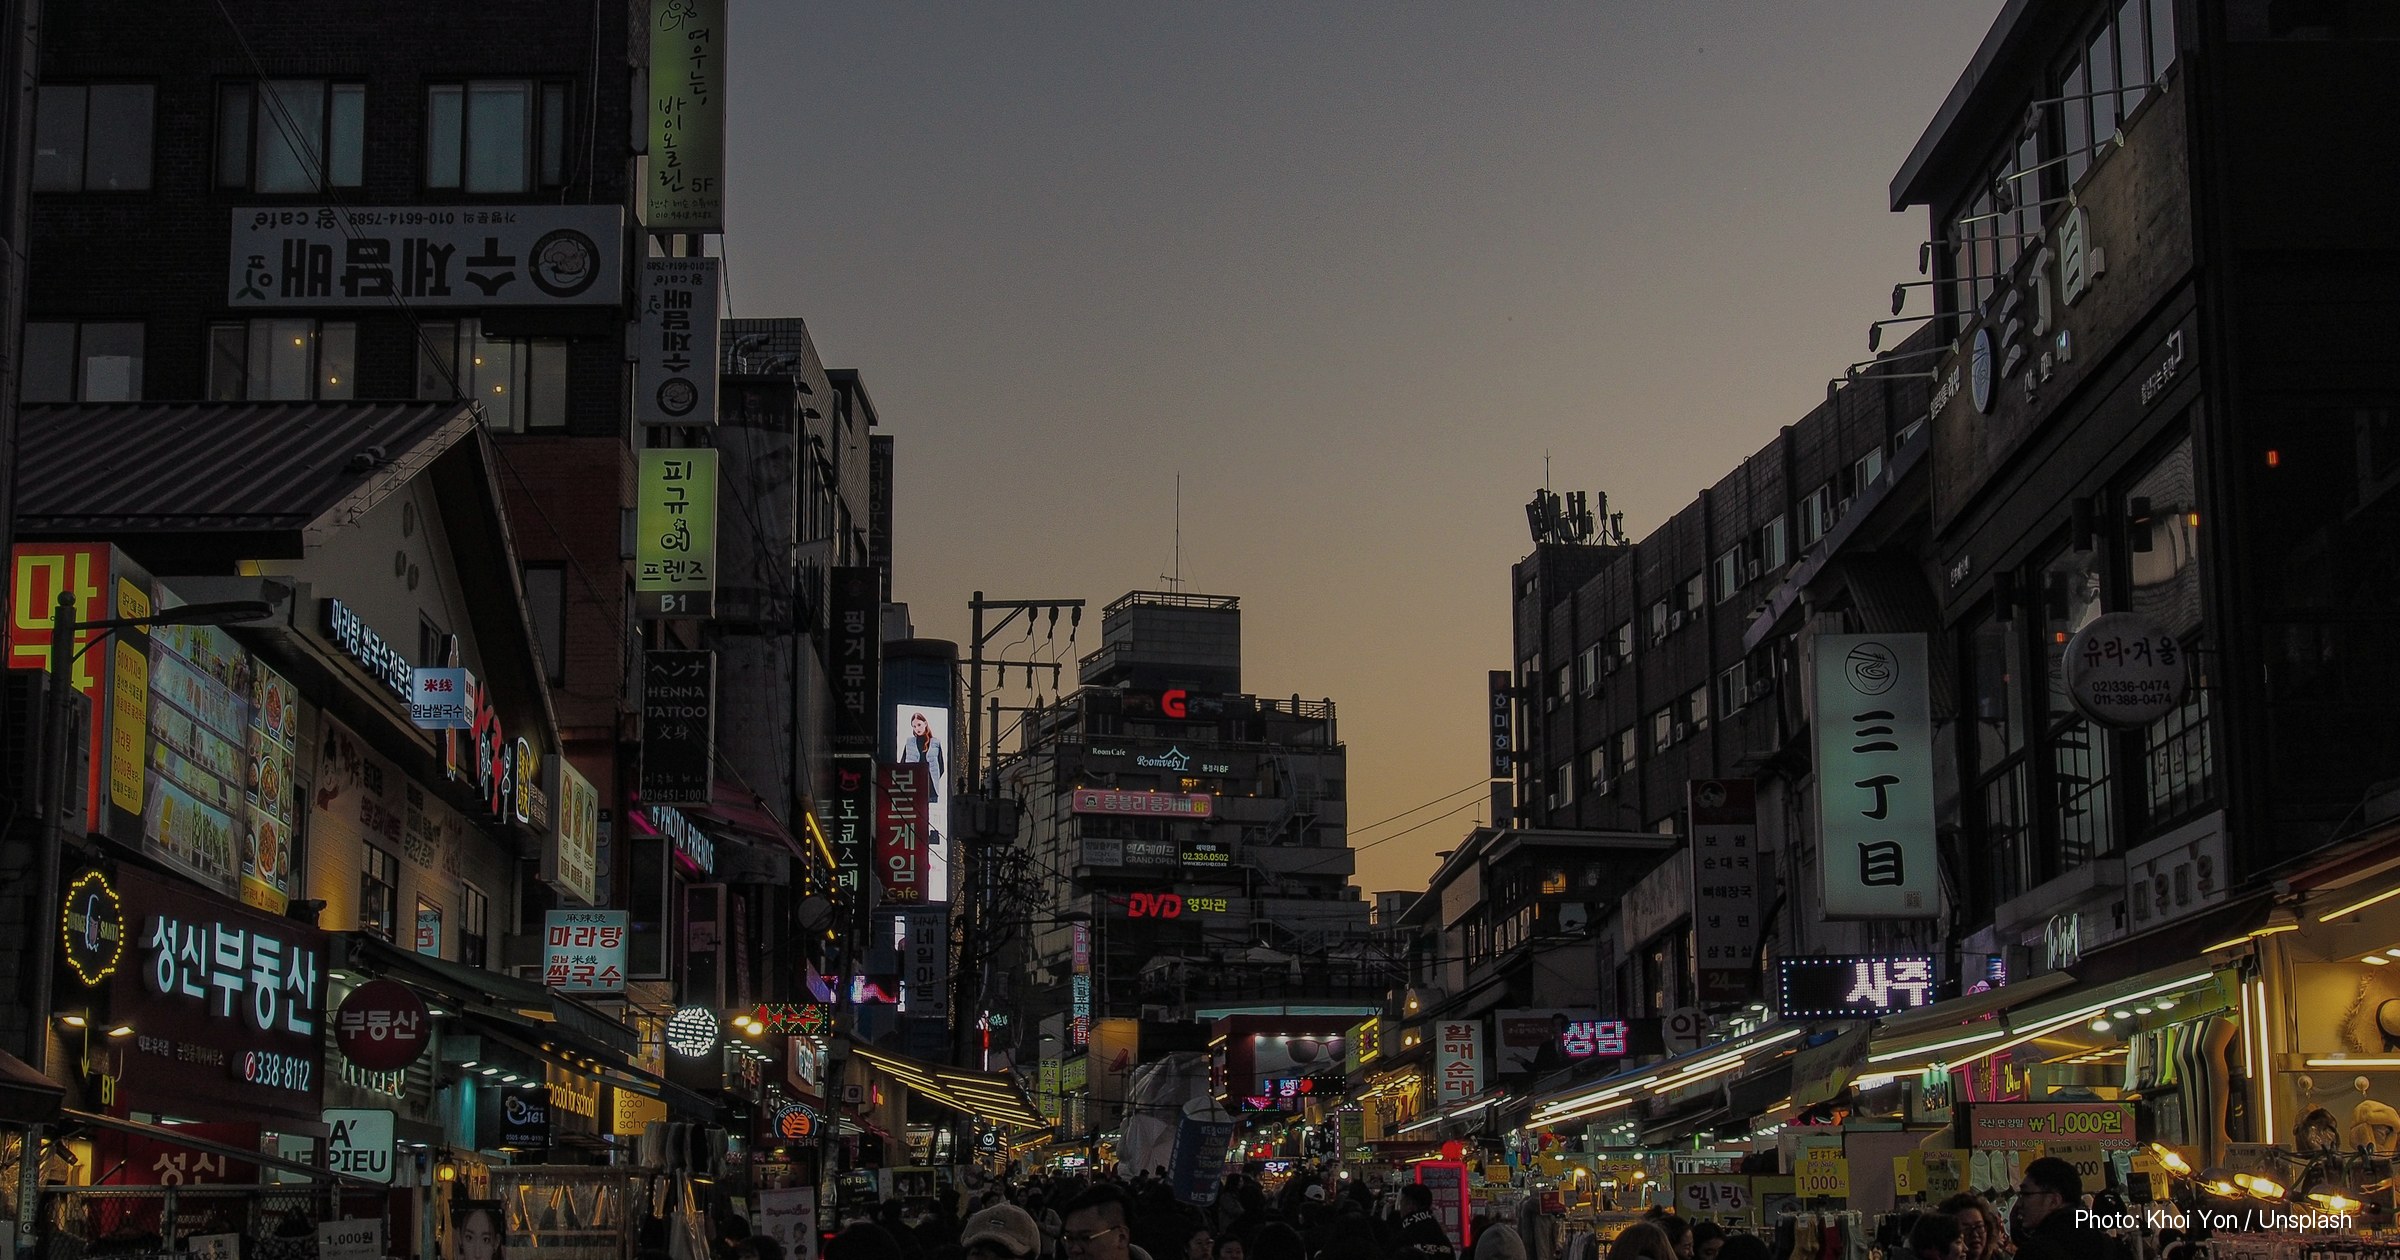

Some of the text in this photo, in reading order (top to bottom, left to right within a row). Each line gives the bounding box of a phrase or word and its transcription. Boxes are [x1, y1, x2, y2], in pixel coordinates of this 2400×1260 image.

[659, 96, 686, 192] 바이올린
[691, 178, 714, 192] 5F
[349, 211, 455, 225] 010-6614-7589
[281, 238, 518, 298] 수제담배
[661, 290, 692, 373] 수제담배
[642, 560, 707, 582] 프렌즈
[660, 594, 687, 612] B1
[651, 660, 705, 677] ヘンナ
[843, 610, 866, 714] 핑거뮤직
[648, 686, 705, 698] HENNA
[2092, 681, 2170, 692] 02)336-0474
[2094, 693, 2172, 705] 011-388-0474
[646, 706, 708, 718] TATTOO
[1092, 748, 1111, 756] Room
[1852, 711, 1905, 887] 三丁目
[888, 770, 917, 882] 보드게임
[660, 806, 714, 875] PHOTO FRIENDS
[1155, 857, 1177, 865] OPEN
[1182, 853, 1229, 861] 02.336.0502
[887, 887, 919, 899] Cafe
[1127, 892, 1182, 919] DVD
[1187, 898, 1227, 913] 영화관
[549, 926, 623, 948] 마라탕
[152, 915, 317, 1036] 성신부동산
[546, 965, 621, 987] 쌀국수
[916, 929, 935, 1002] 네일아트
[1846, 959, 1929, 1008] 사주
[340, 1010, 420, 1041] 부동산
[1562, 1020, 1630, 1058] 상담
[255, 1051, 310, 1092] 338-8112
[101, 1075, 116, 1107] B1
[576, 1088, 595, 1119] school
[619, 1098, 645, 1107] cool
[619, 1108, 635, 1119] for
[1979, 1118, 1995, 1128] 국산
[2007, 1118, 2024, 1128] 양말
[1979, 1139, 2005, 1148] MADE
[2008, 1139, 2018, 1148] IN
[2100, 1139, 2131, 1147] SOCKS
[329, 1150, 387, 1173] PIEU
[1688, 1185, 1742, 1209] 힐링
[326, 1232, 374, 1245] 1,000원
